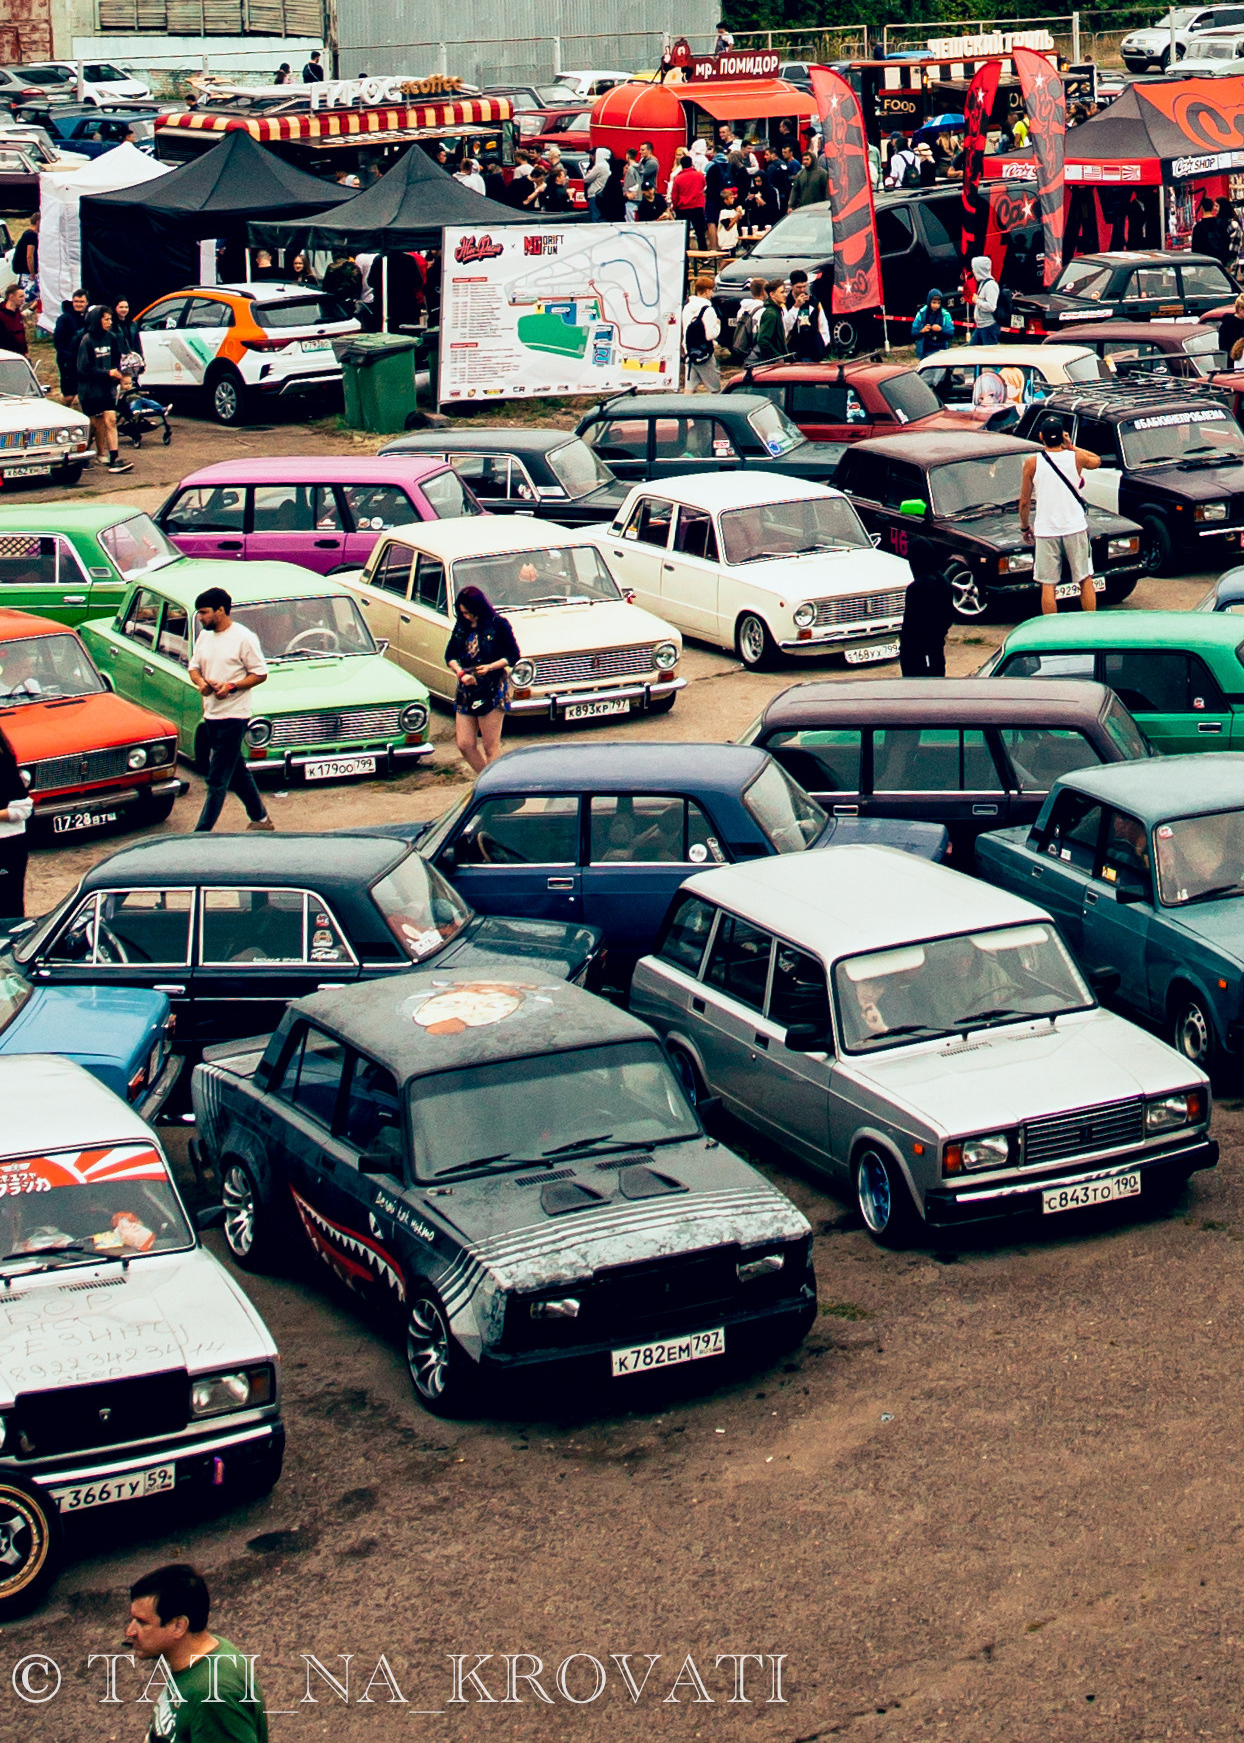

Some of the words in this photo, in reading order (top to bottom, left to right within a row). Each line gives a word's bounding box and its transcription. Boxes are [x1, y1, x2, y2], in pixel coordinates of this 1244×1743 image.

[720, 55, 779, 75] ПОМИДОР
[311, 77, 402, 108] ГИРОС
[884, 99, 916, 113] FOOD
[1194, 158, 1215, 170] SHOP
[542, 245, 558, 255] FUN
[569, 703, 609, 718] К893КР
[610, 699, 627, 710] 797
[309, 762, 354, 777] К179ОО
[355, 758, 373, 770] 799
[56, 813, 90, 832] 17-28
[1046, 1184, 1112, 1211] С843ТО
[1116, 1177, 1138, 1195] 190
[617, 1343, 691, 1373] К782ЕМ
[693, 1331, 718, 1350] 797
[146, 1468, 165, 1488] 59
